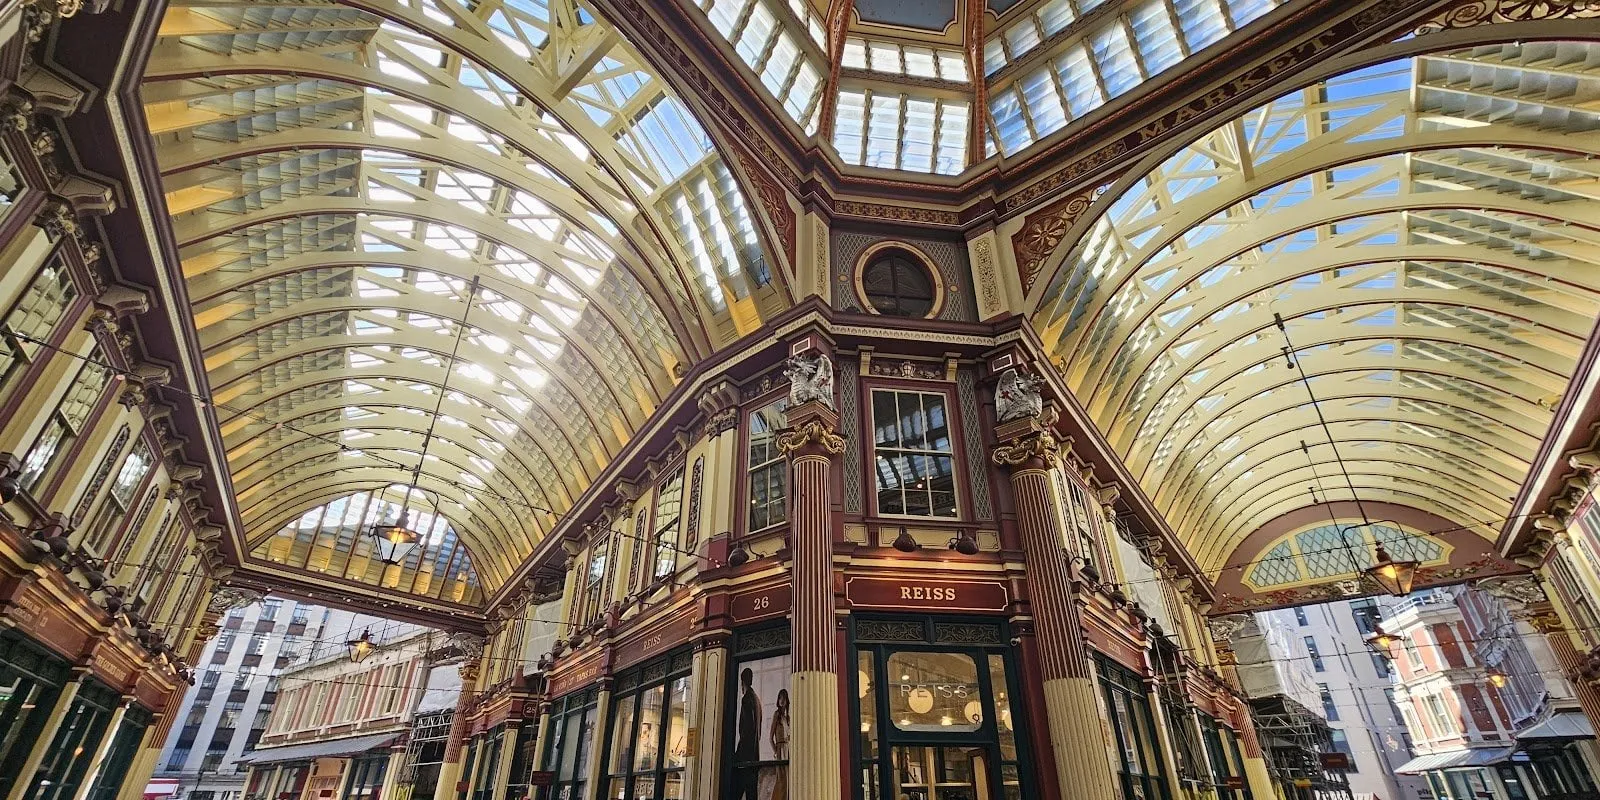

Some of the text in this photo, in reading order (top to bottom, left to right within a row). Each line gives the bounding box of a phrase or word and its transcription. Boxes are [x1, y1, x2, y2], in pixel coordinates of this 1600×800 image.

[1138, 30, 1336, 144] MARKET
[901, 587, 956, 601] REISS
[753, 597, 769, 611] 26
[643, 634, 662, 651] REISS
[900, 684, 968, 698] REISS
